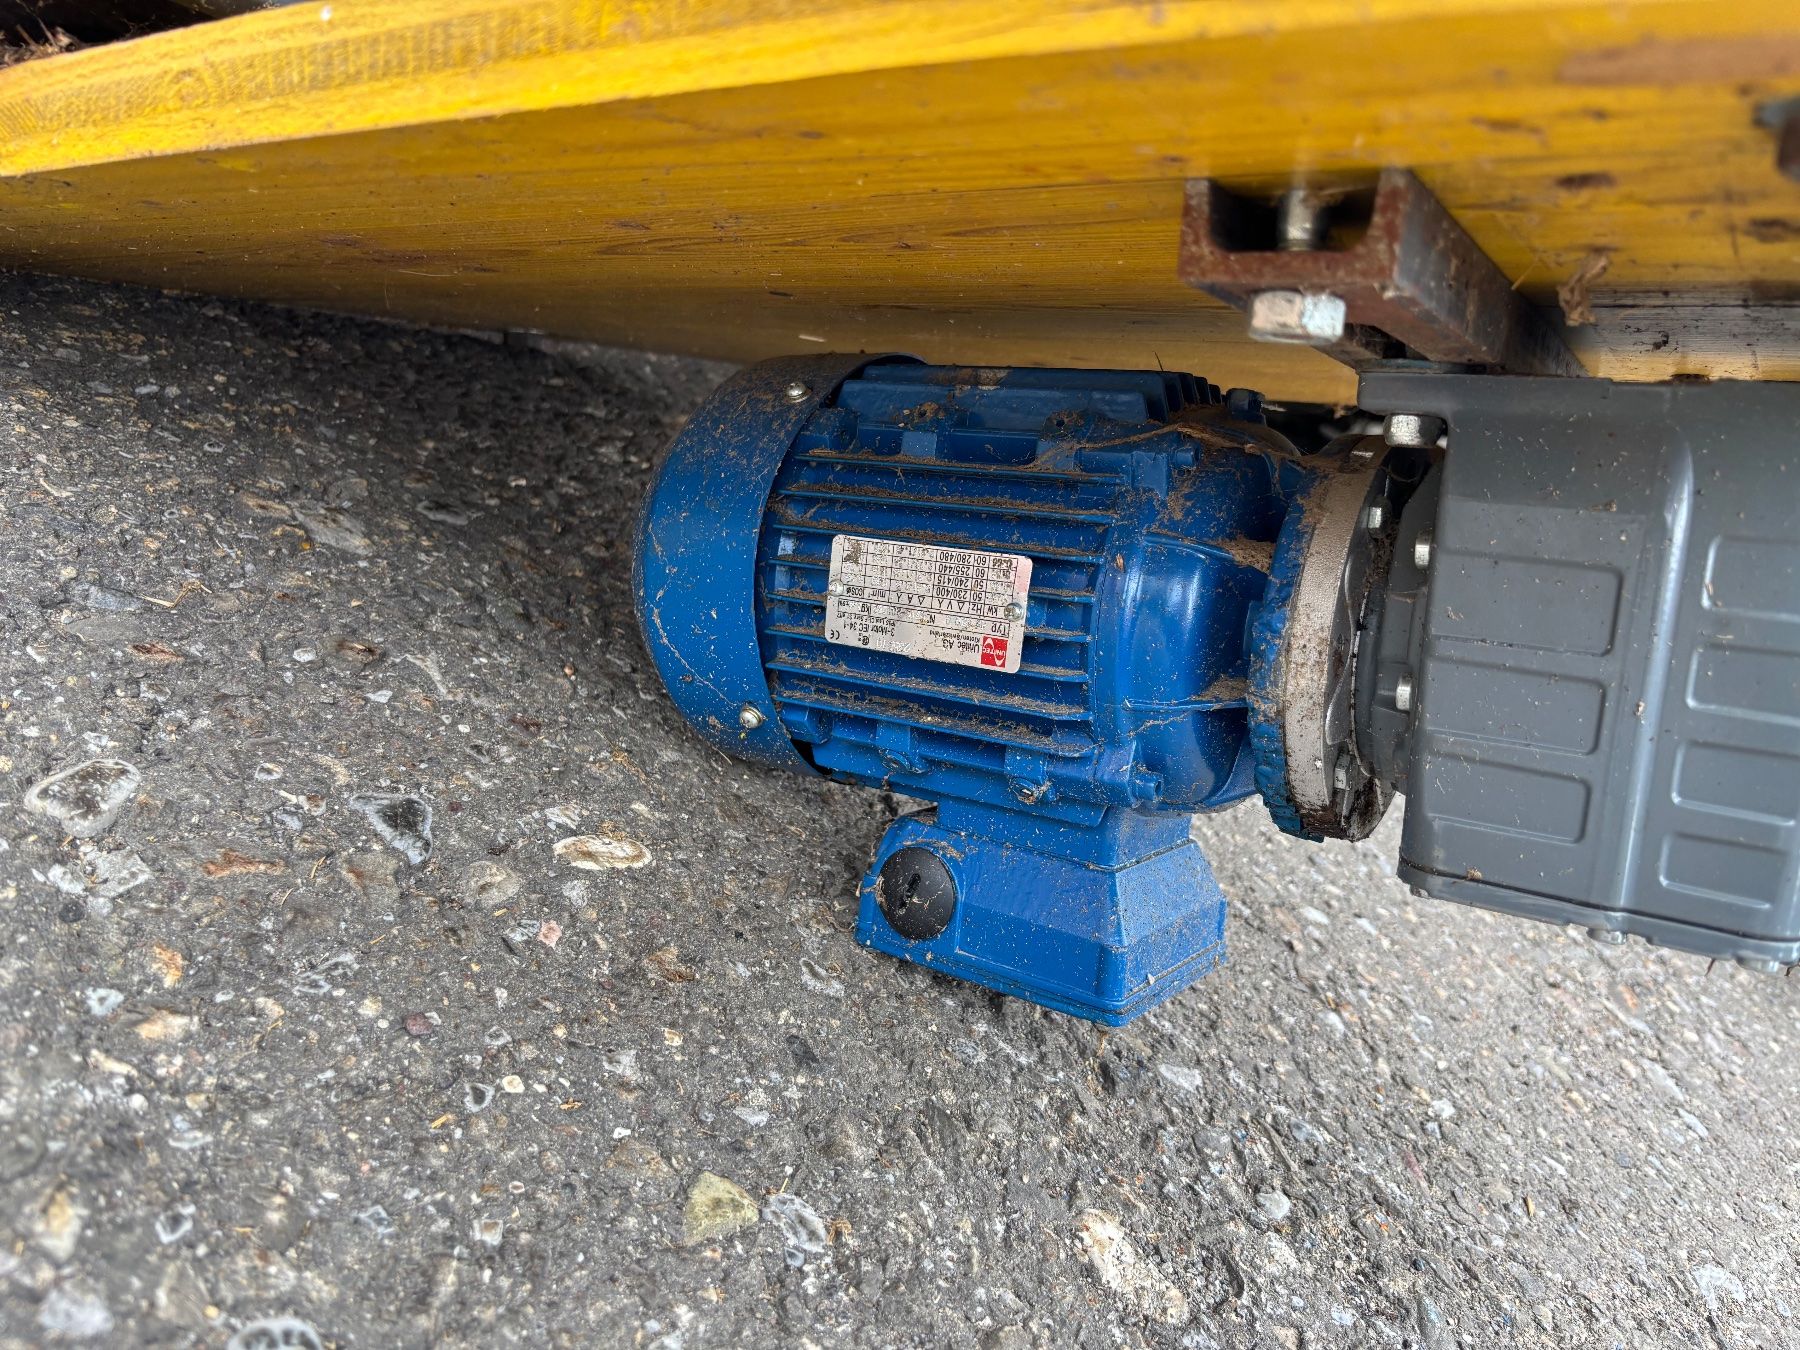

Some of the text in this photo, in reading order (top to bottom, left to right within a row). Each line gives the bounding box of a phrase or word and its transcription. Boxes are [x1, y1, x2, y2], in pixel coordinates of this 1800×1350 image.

[939, 550, 971, 565] 280/480
[976, 555, 987, 566] 60
[938, 562, 970, 577] 255/440
[974, 567, 985, 578] 60
[936, 574, 969, 588] 240/415
[973, 579, 984, 590] 50
[935, 586, 968, 600] 230/400
[971, 591, 982, 602] 50
[946, 600, 953, 610] V
[970, 603, 982, 614] Hz
[986, 605, 998, 616] kW
[990, 622, 1007, 635] Typ
[829, 629, 840, 640] CE
